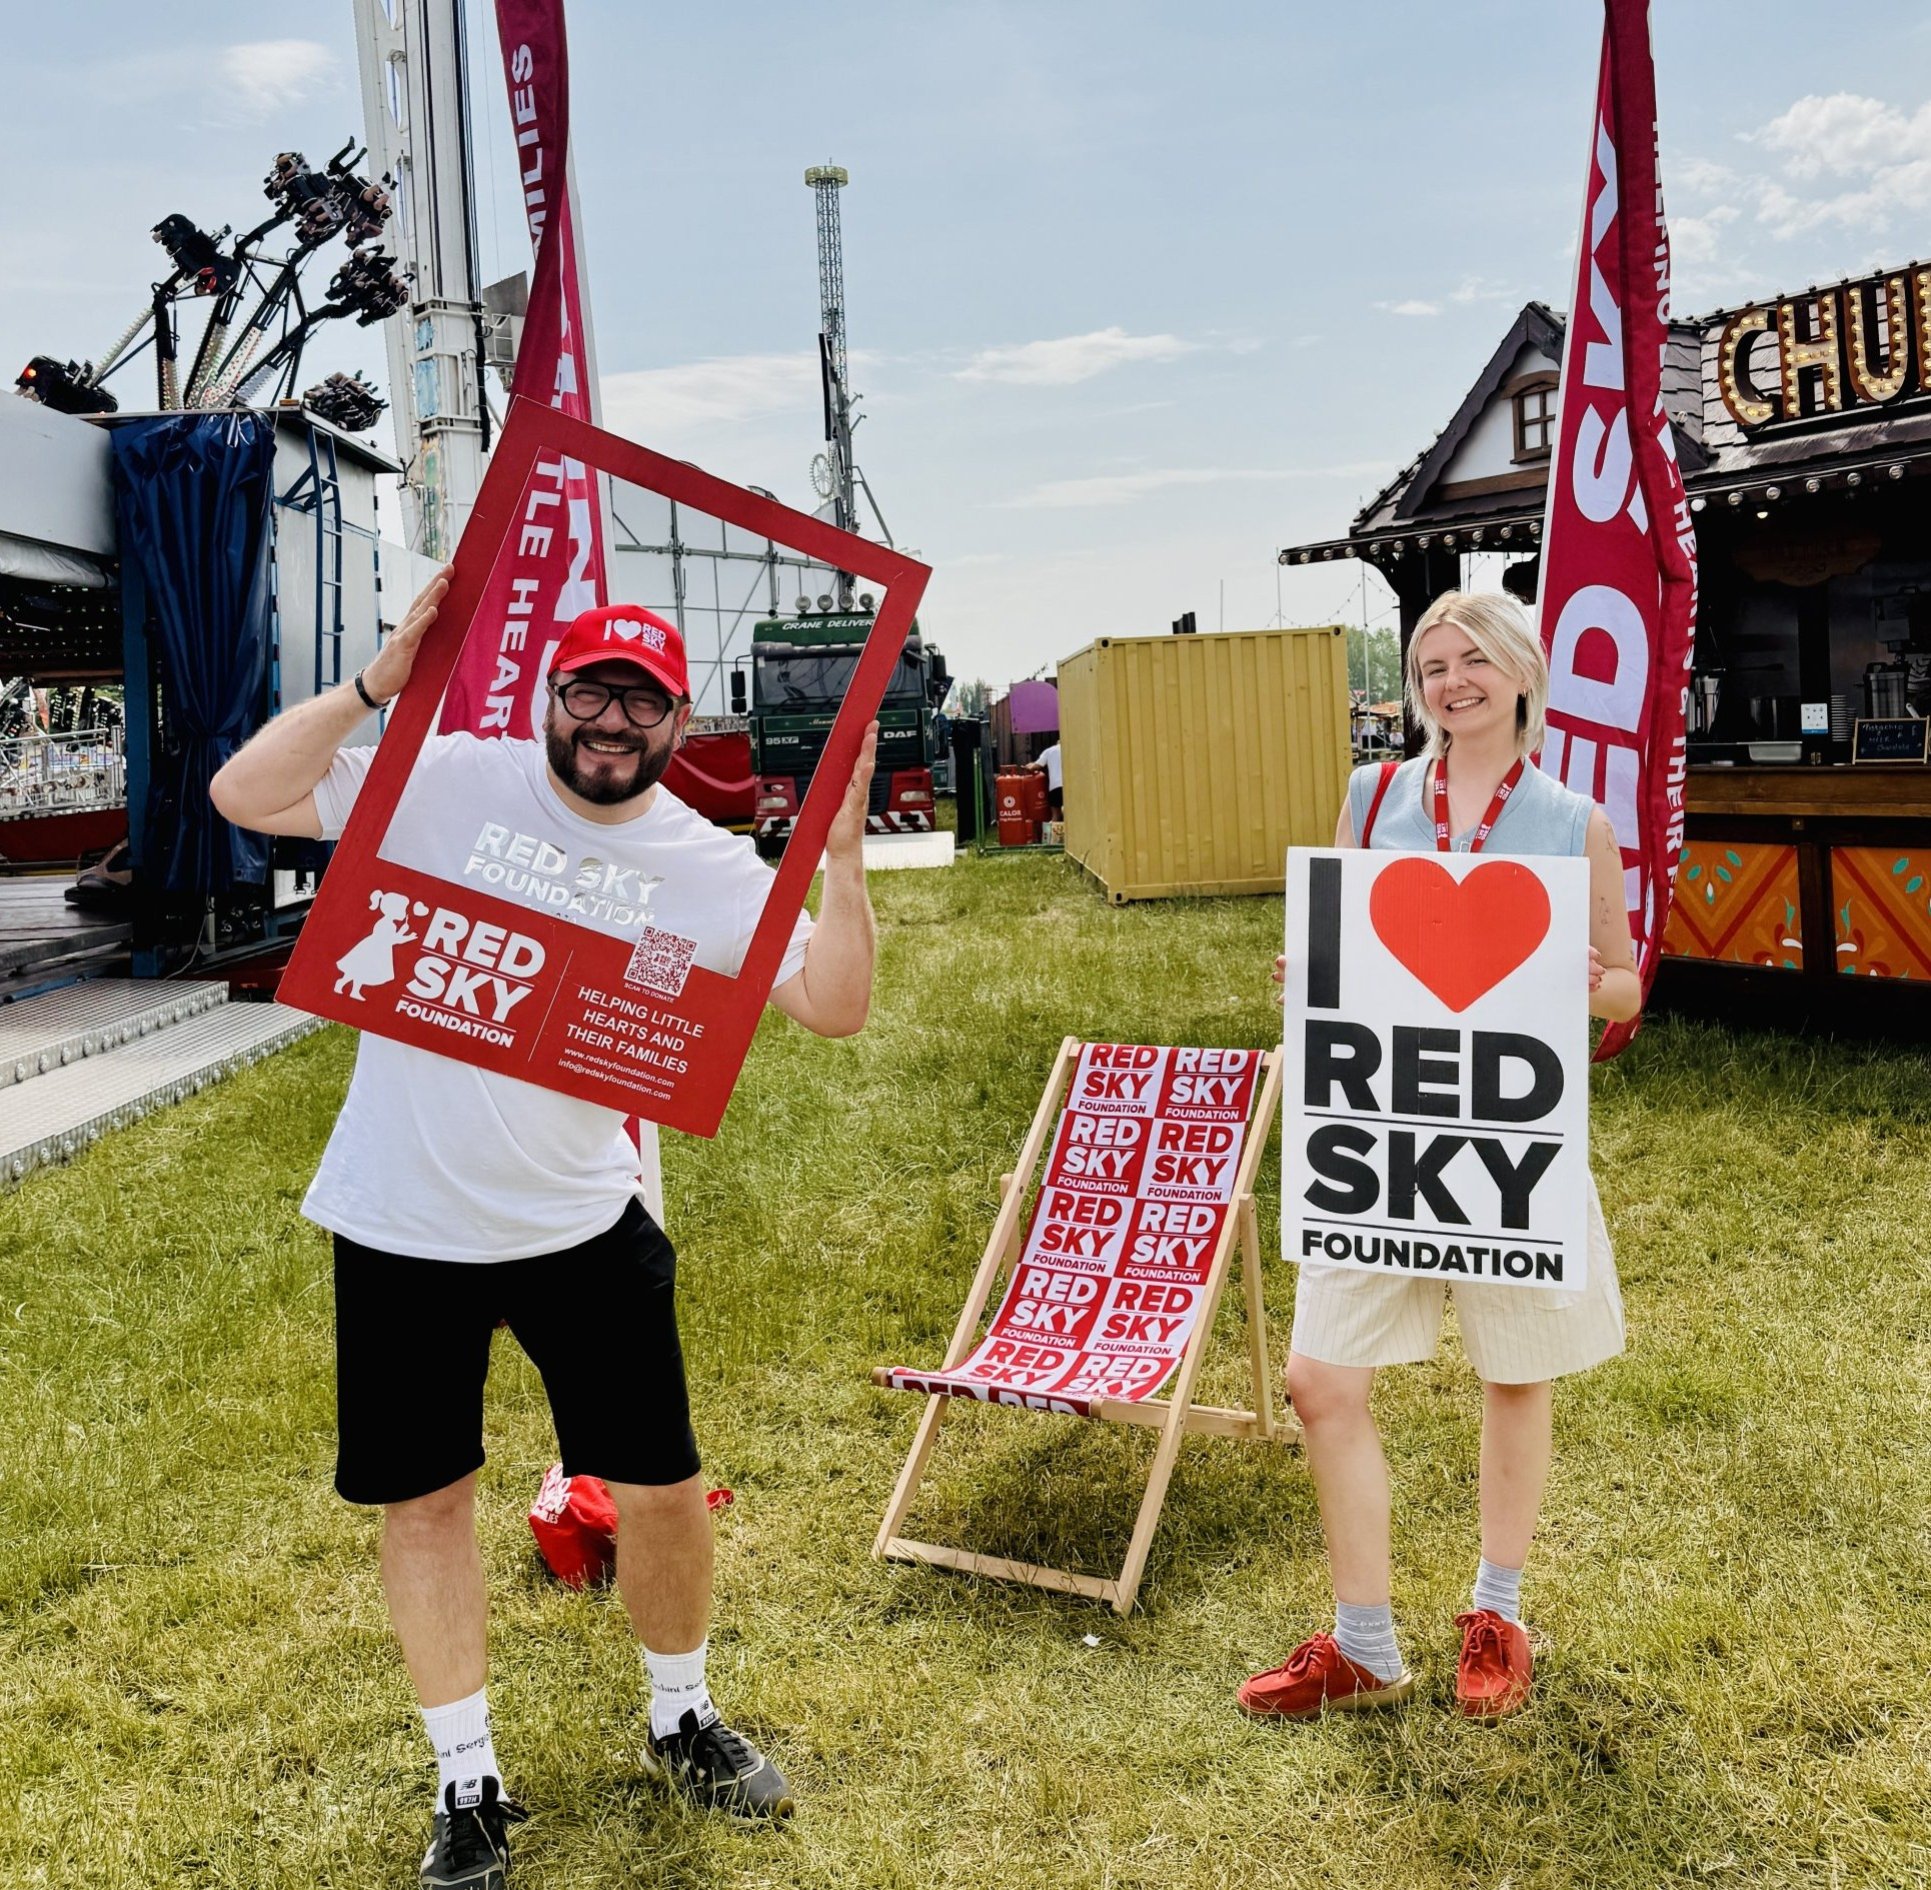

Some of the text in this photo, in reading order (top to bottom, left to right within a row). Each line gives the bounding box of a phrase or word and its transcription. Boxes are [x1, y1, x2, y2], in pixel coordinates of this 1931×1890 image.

[511, 43, 546, 261] MILIES
[1718, 267, 1931, 426] CHU
[518, 460, 565, 559] TLE
[603, 619, 667, 641] I RED
[782, 619, 875, 630] CRANE DELIVER
[642, 633, 666, 651] SKY
[479, 578, 539, 740] HEAR
[883, 730, 917, 739] DAF
[474, 821, 666, 905] RED SKY
[464, 855, 656, 928] FOUNDATION
[422, 907, 546, 978] RED
[1307, 857, 1342, 1009] I
[405, 956, 533, 1023] SKY
[624, 983, 641, 993] SCAN
[650, 991, 674, 1003] DONATE
[395, 999, 514, 1048] FOUNDATION
[577, 986, 704, 1038] HELPING LITTLE
[583, 1009, 685, 1051] HEARTS AND
[566, 1023, 688, 1074] THEIR FAMILIES
[1089, 1044, 1159, 1069] RED
[1174, 1049, 1248, 1074] RED
[558, 1058, 671, 1100] info@redskyfoundation.com
[564, 1047, 674, 1088] www.redskyfoundation.com
[1304, 1019, 1564, 1123] RED
[1083, 1071, 1152, 1099] SKY
[1169, 1076, 1243, 1106] SKY
[1078, 1100, 1147, 1114] FOUNDATION
[1165, 1107, 1239, 1120] FOUNDATION
[1069, 1115, 1142, 1147] RED
[1158, 1123, 1233, 1154] RED
[1062, 1146, 1135, 1178] SKY
[1152, 1155, 1228, 1186] SKY
[1303, 1124, 1564, 1230] SKY
[1056, 1175, 1128, 1193] FOUNDATION
[1147, 1187, 1222, 1200] FOUNDATION
[1047, 1191, 1123, 1227] RED
[1138, 1202, 1216, 1235] RED
[1039, 1223, 1116, 1257] SKY
[1130, 1235, 1209, 1268] SKY
[1302, 1229, 1564, 1282] FOUNDATION
[1033, 1254, 1106, 1273] FOUNDATION
[1124, 1266, 1201, 1282] FOUNDATION
[1021, 1268, 1098, 1305] RED
[1113, 1282, 1193, 1314] RED
[1009, 1299, 1090, 1334] SKY
[1101, 1313, 1185, 1342] SKY
[1001, 1328, 1077, 1348] FOUNDATION
[1094, 1343, 1172, 1355] FOUNDATION
[984, 1340, 1064, 1370] RED
[1078, 1355, 1161, 1378] RED
[969, 1364, 1051, 1386] SKY
[1061, 1378, 1149, 1396] SKY
